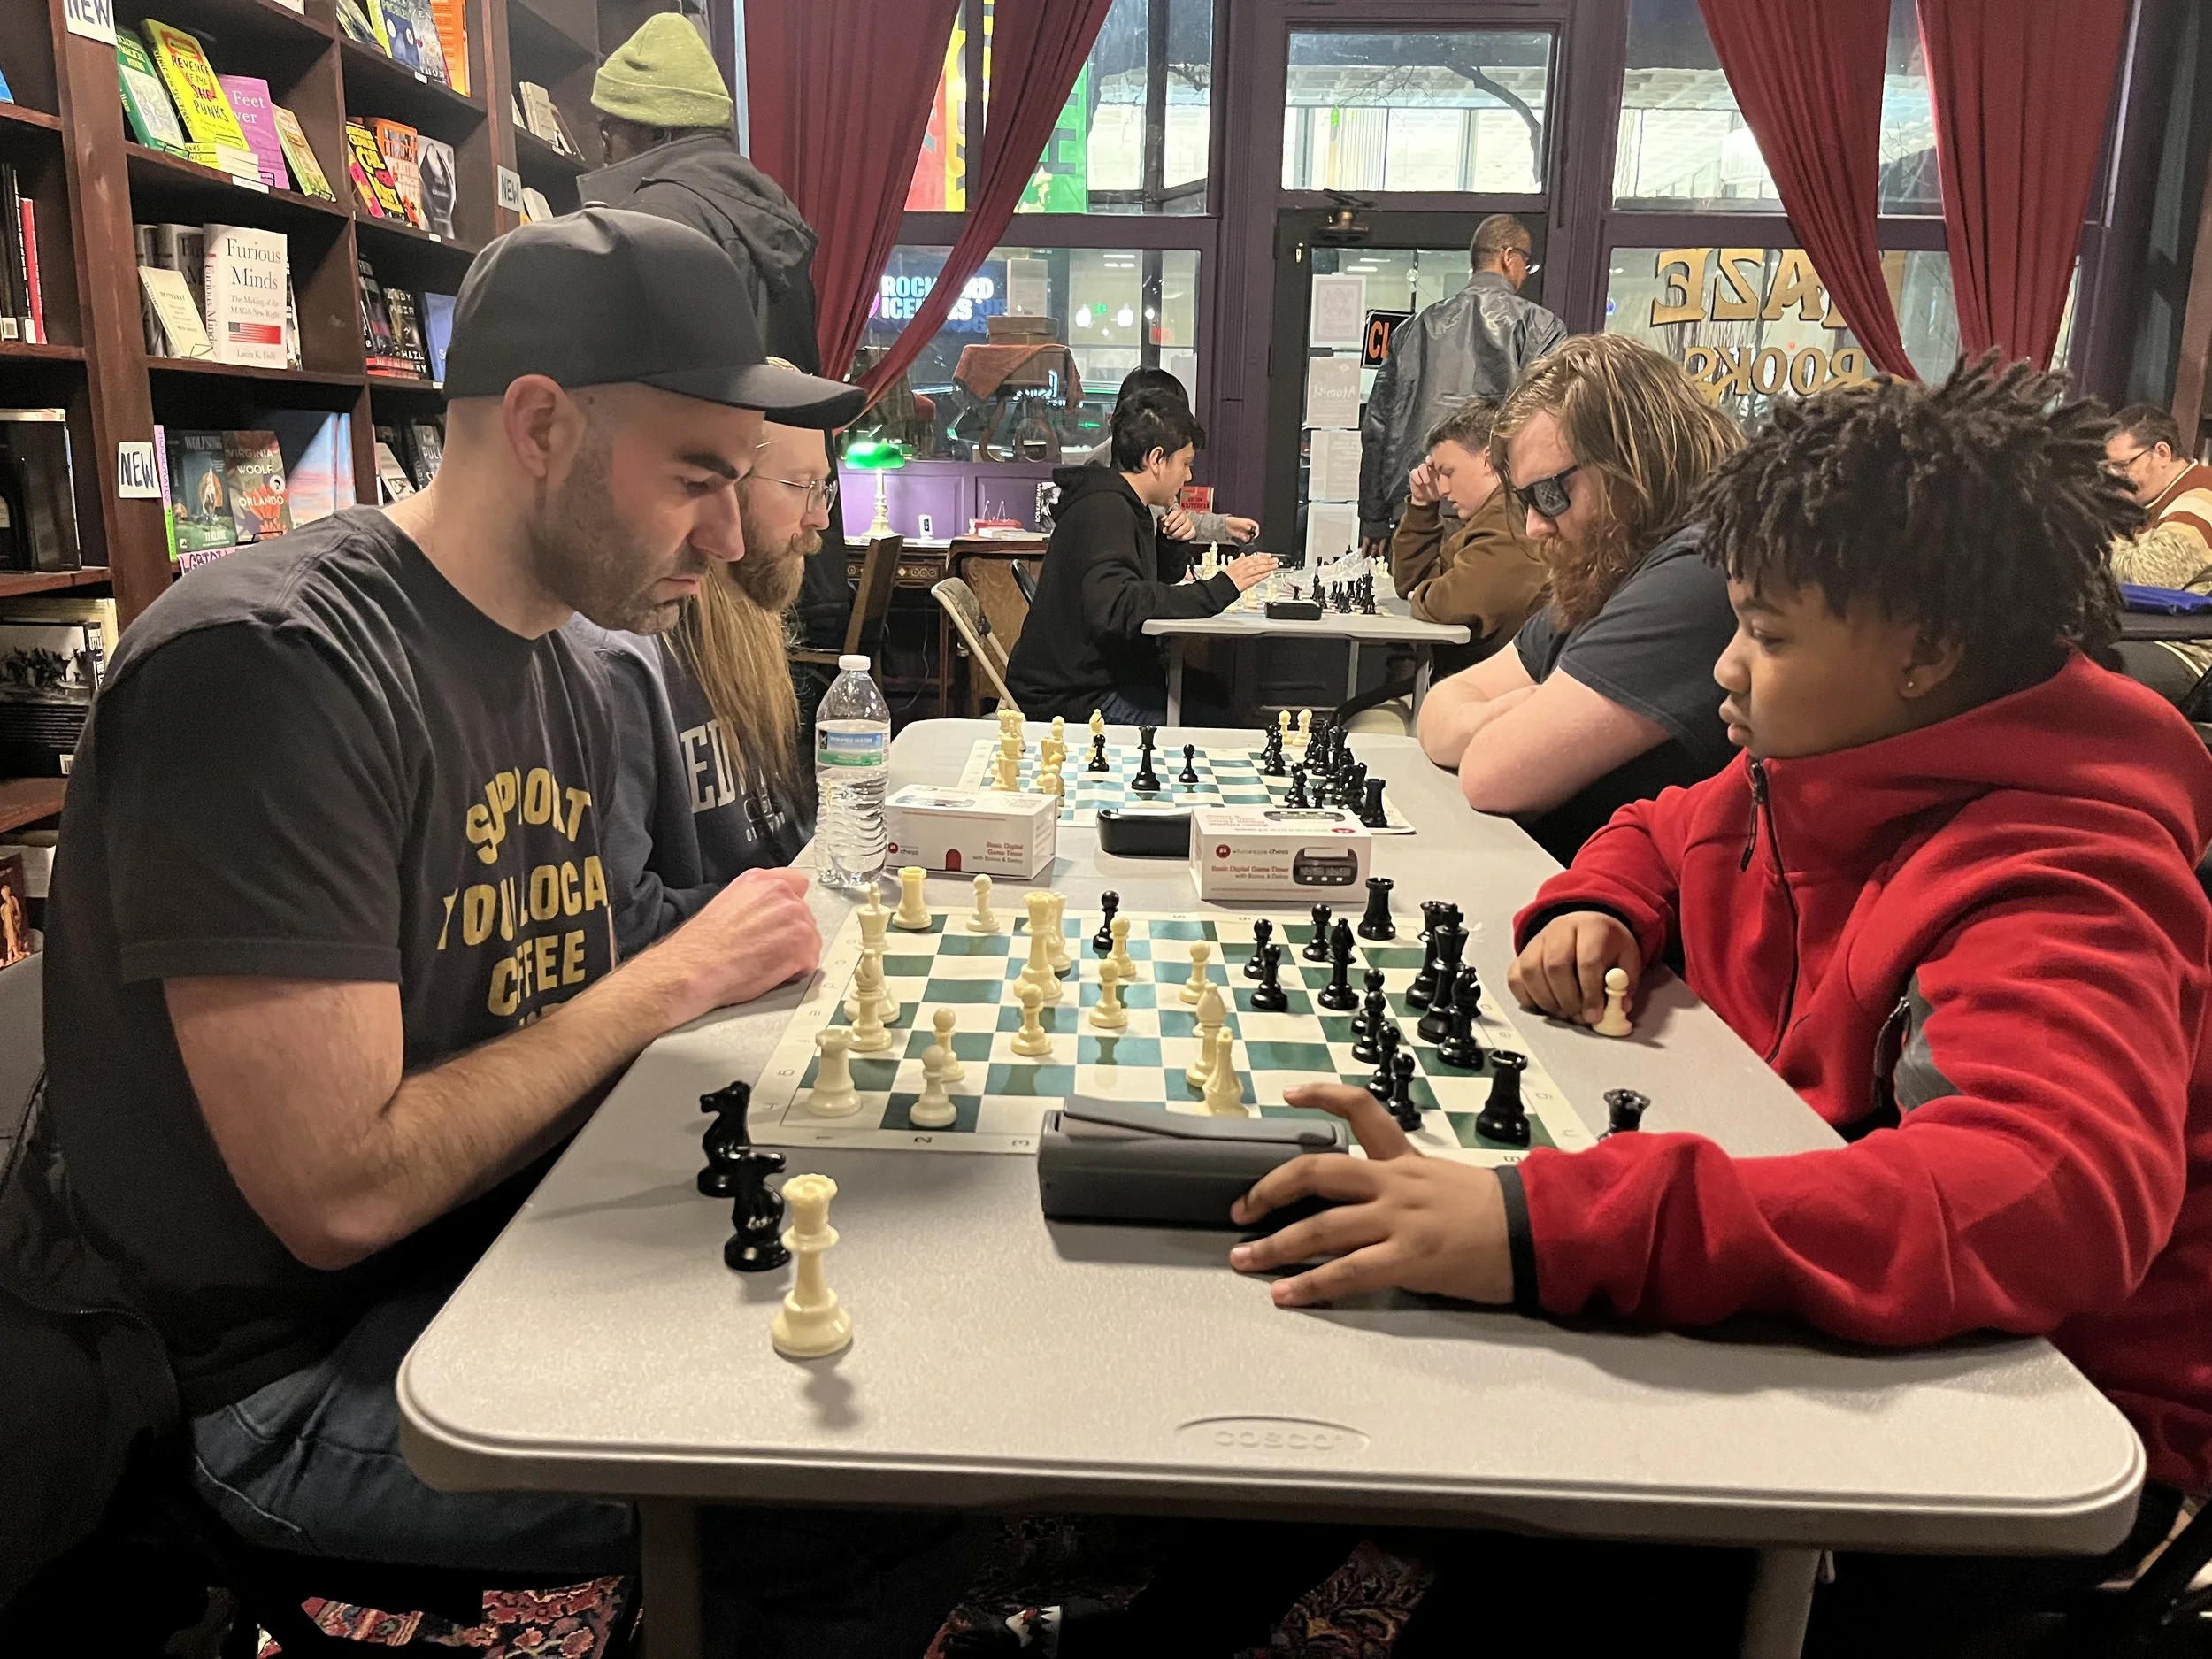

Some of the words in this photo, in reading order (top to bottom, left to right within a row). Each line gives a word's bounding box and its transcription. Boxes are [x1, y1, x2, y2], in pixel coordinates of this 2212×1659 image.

[67, 0, 111, 29] NEW
[171, 55, 211, 75] REVENGE
[193, 100, 230, 123] PUNKS
[232, 90, 265, 110] Feet
[233, 111, 257, 125] ver
[500, 175, 520, 204] NEW
[226, 237, 282, 265] Furious
[204, 264, 215, 307] Furious
[231, 266, 279, 290] Minds
[880, 275, 995, 300] ROCKRD
[230, 306, 253, 315] MAGA
[880, 296, 973, 321] ICEGS
[206, 311, 218, 347] Minds
[227, 448, 273, 459] VIRGINIA
[120, 447, 155, 489] NEW
[237, 465, 273, 475] WOOLF
[239, 495, 284, 507] ORLANDO
[1004, 841, 1024, 850] Digital
[914, 1136, 933, 1145] 2
